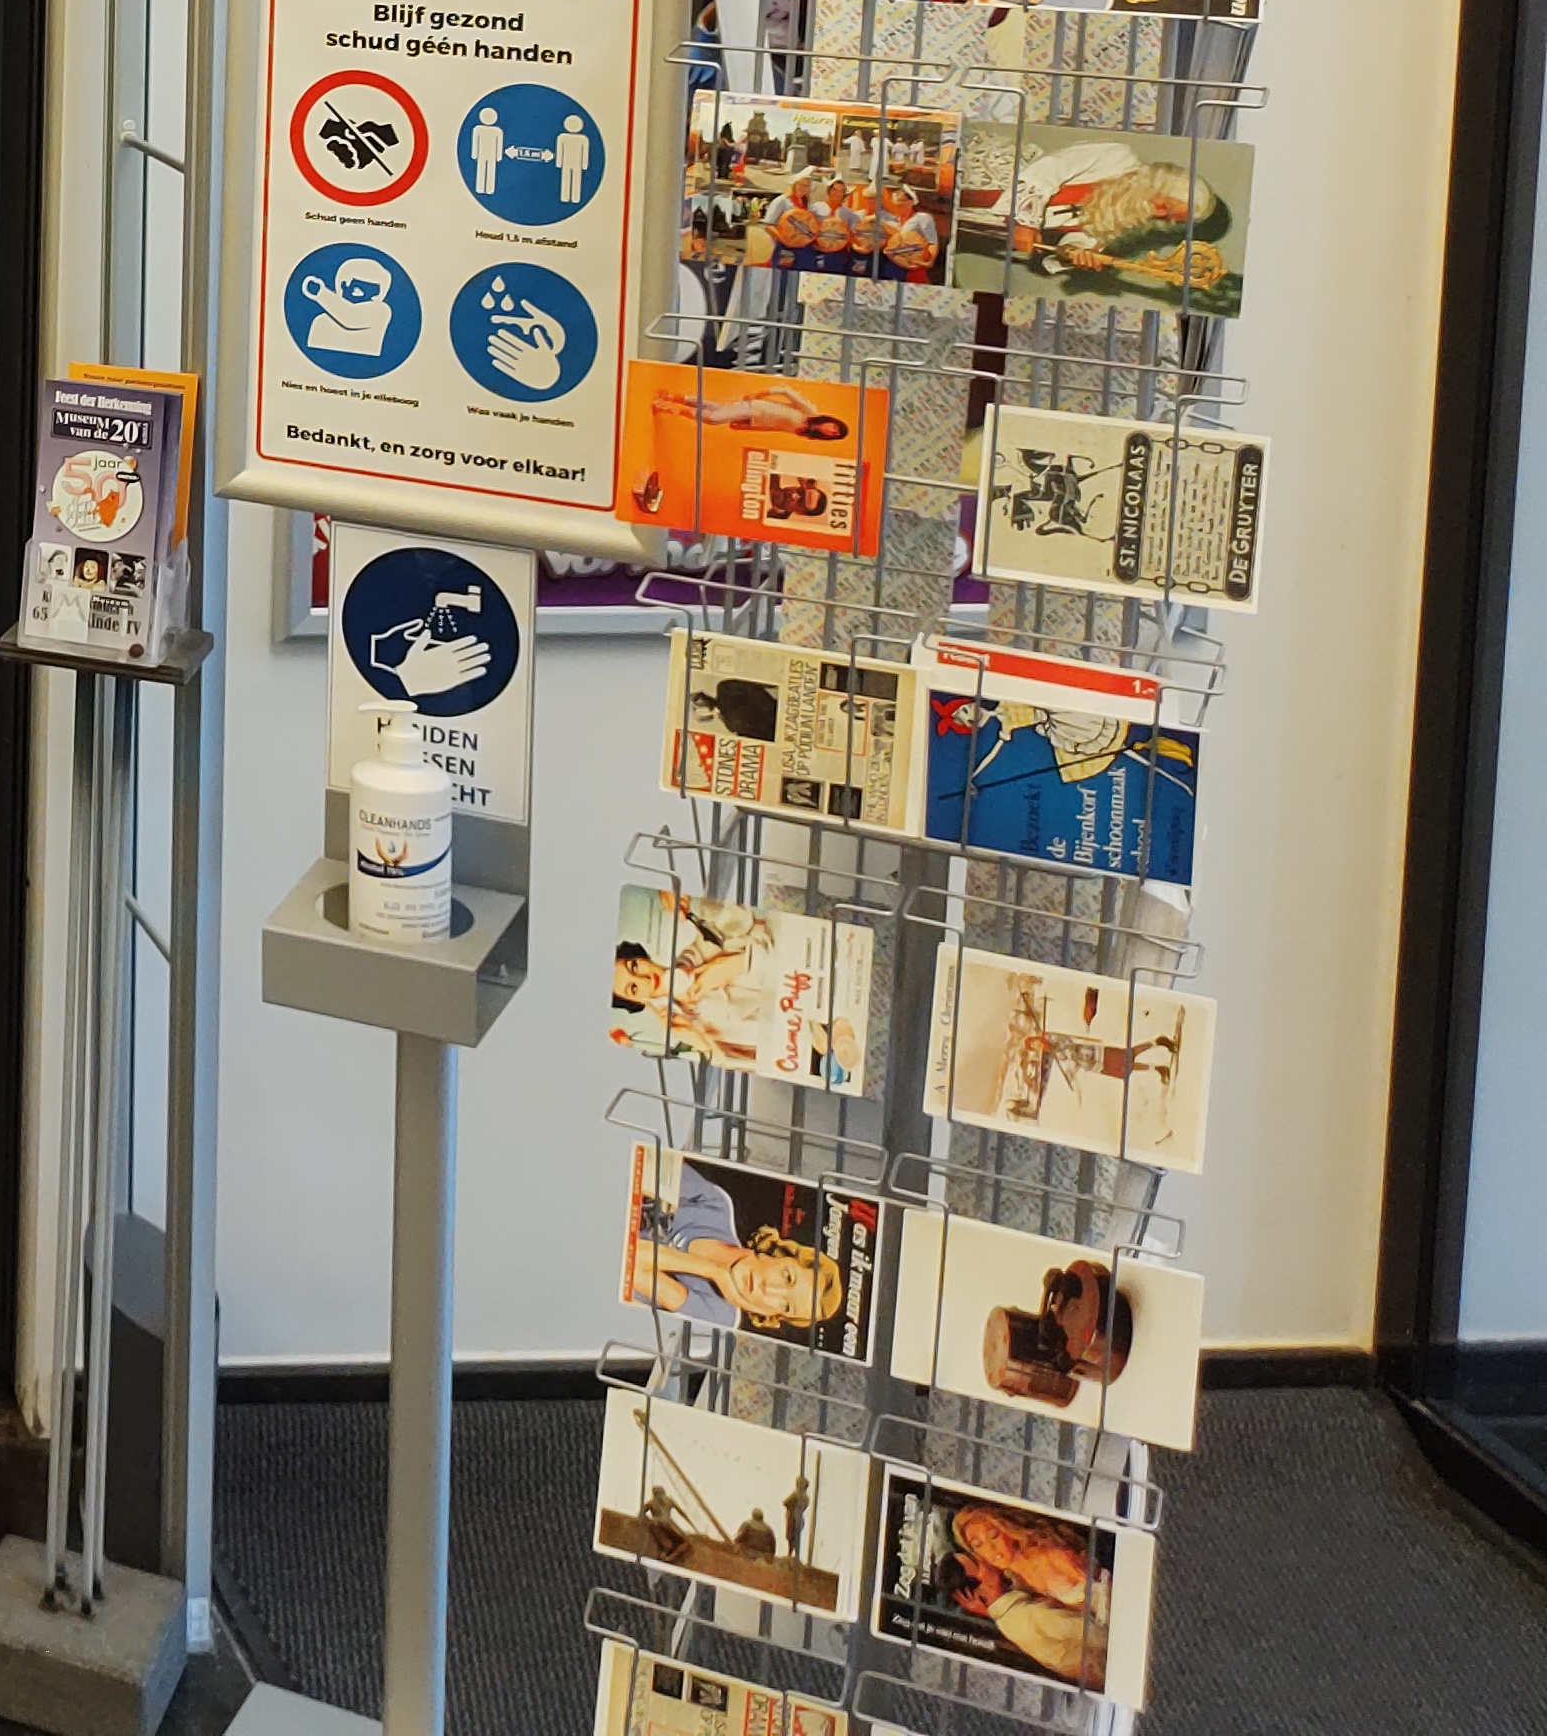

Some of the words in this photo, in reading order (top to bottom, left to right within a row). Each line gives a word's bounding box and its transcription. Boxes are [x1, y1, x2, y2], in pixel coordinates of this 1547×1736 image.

[373, 3, 426, 28] Blijf
[430, 10, 525, 33] gezond
[325, 29, 400, 52] schud
[405, 35, 468, 58] géén
[474, 39, 574, 65] handen
[304, 210, 338, 222] Schud
[339, 215, 366, 226] geen
[367, 217, 407, 230] handen
[474, 229, 504, 241] Houd
[534, 236, 578, 249] afstand
[54, 390, 79, 405] Feest
[79, 394, 97, 407] der
[280, 380, 304, 391] Nies
[305, 384, 318, 392] en
[319, 384, 348, 397] hoest
[349, 388, 361, 399] in
[361, 390, 372, 401] je
[373, 393, 420, 408] elleboog
[466, 404, 490, 416] Was
[492, 409, 517, 420] vaak
[518, 412, 530, 423] je
[531, 414, 576, 428] handen
[69, 427, 92, 438] van
[93, 427, 109, 440] de
[93, 455, 122, 471] jaar
[286, 423, 376, 453] Bedankt,
[379, 440, 405, 455] en
[409, 445, 456, 466] zorg
[460, 451, 508, 470] voor
[512, 459, 587, 482] elkaar!
[1122, 443, 1146, 538] NICOLAAS
[1230, 463, 1259, 556] GRUYTER
[1118, 543, 1137, 568] ST.
[1228, 556, 1250, 584] DE
[32, 605, 49, 621] 65
[714, 737, 737, 796] STONES
[738, 744, 761, 801] DRAMA
[359, 808, 432, 831] CLEANHANDS
[1072, 783, 1101, 865] Bijenkorf
[1102, 766, 1126, 869] schoonmaak
[1046, 836, 1067, 860] de
[780, 969, 812, 1013] Puff
[775, 1014, 802, 1072] Creme
[935, 1035, 951, 1073] Merry
